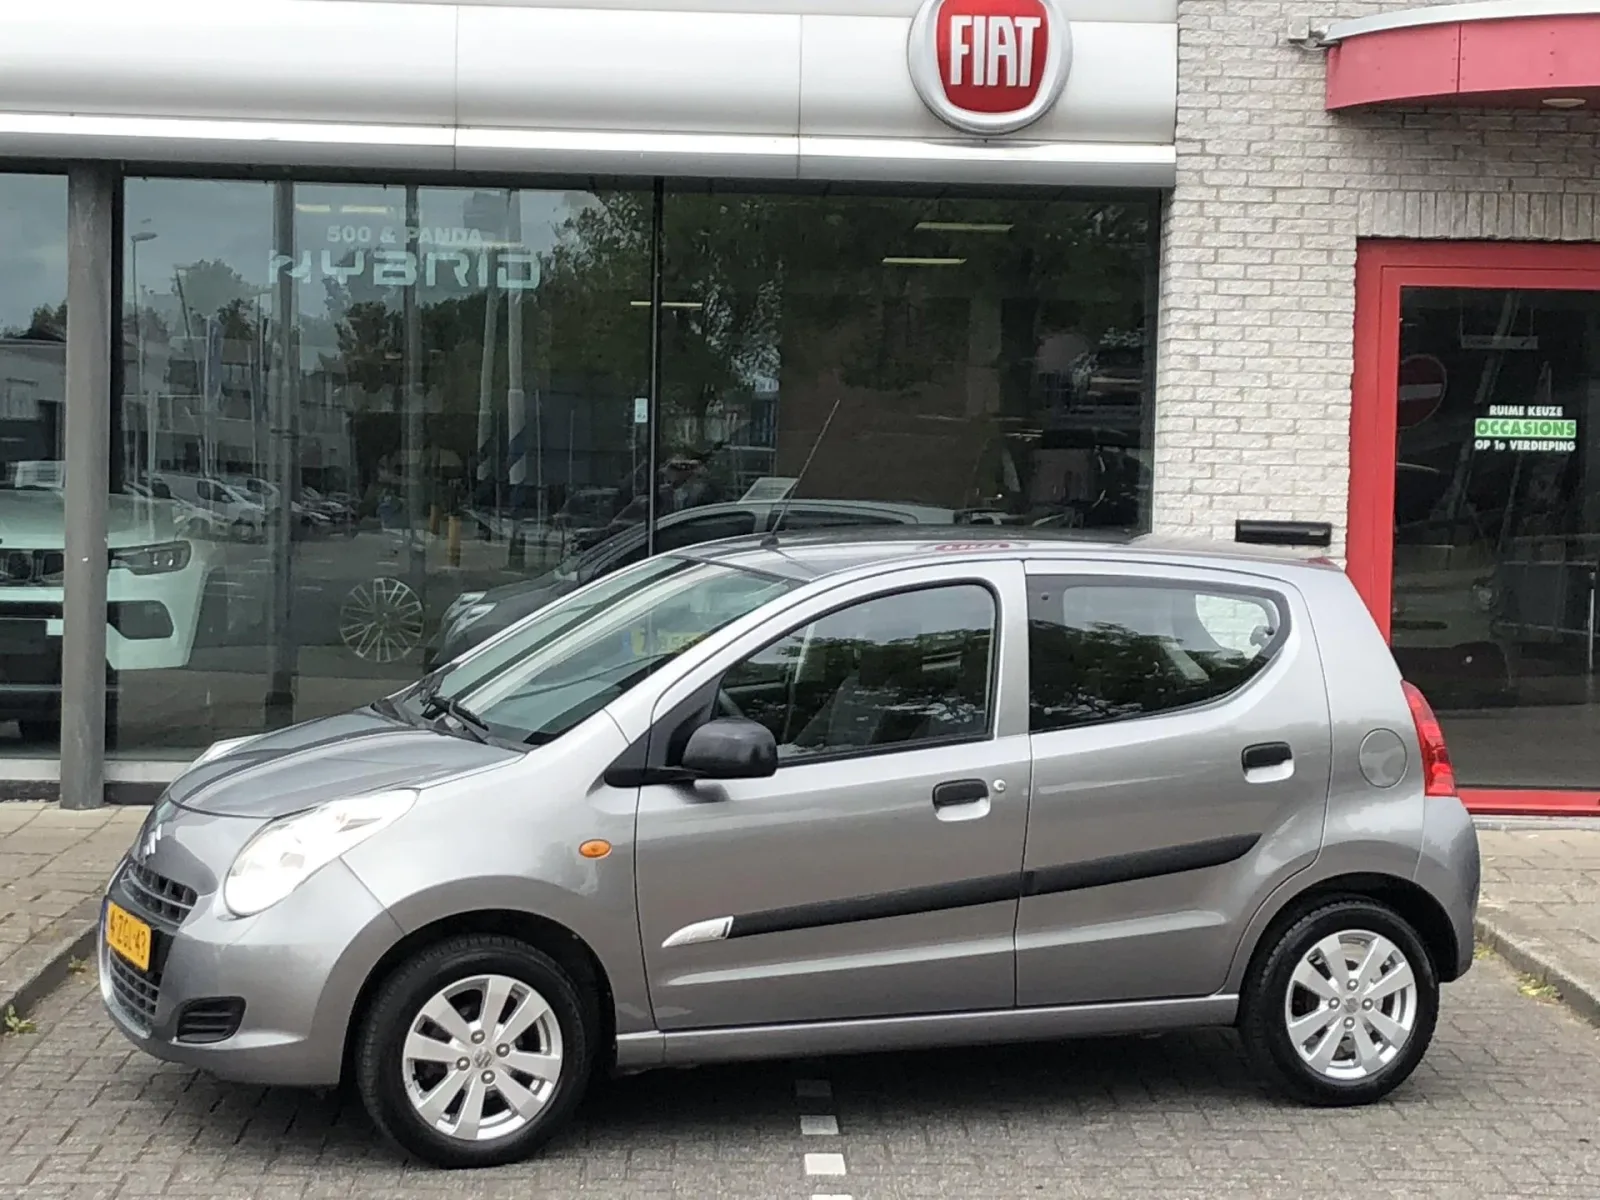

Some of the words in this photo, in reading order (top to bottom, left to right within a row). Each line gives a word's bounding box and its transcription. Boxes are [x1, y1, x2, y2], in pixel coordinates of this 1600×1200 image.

[950, 14, 1041, 87] FIAT
[327, 226, 372, 242] 500
[379, 226, 397, 244] &
[406, 227, 484, 246] PANDA
[268, 249, 541, 289] HYBRID
[1489, 405, 1525, 416] RUIME
[1527, 406, 1563, 417] KEUZE
[1476, 420, 1575, 436] OCCASIONS
[1474, 440, 1491, 450] OP
[1509, 440, 1576, 452] VERDIEPING
